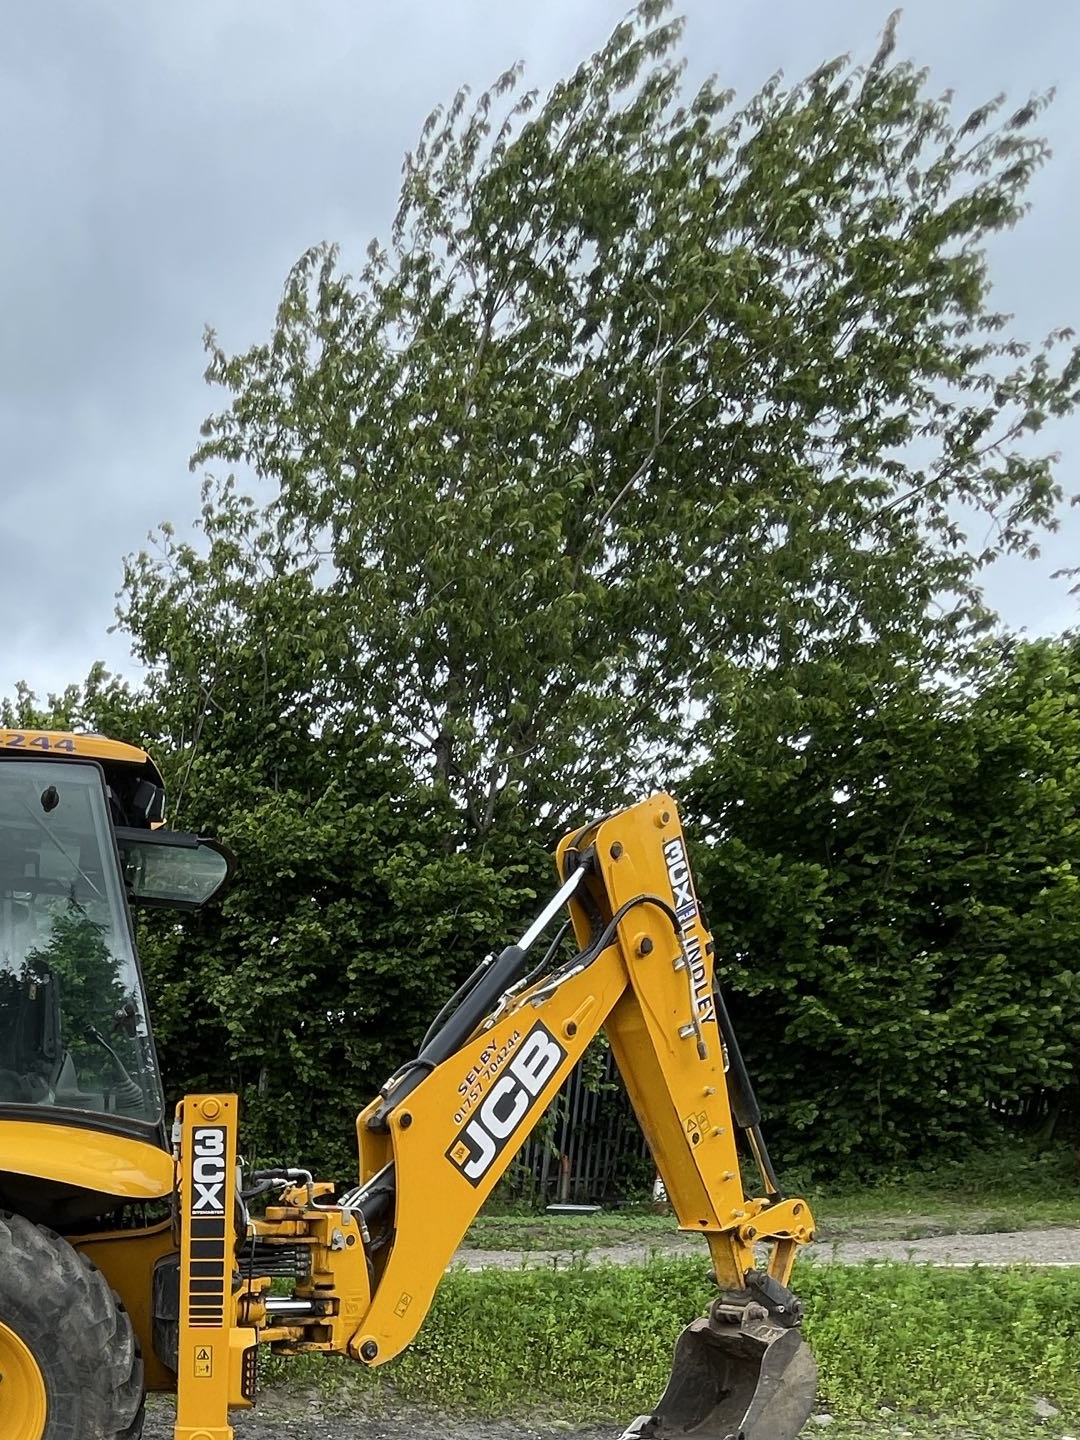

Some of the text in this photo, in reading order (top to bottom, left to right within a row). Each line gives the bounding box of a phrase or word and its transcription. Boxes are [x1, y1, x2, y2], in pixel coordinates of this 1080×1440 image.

[664, 839, 694, 909] 3CX
[682, 922, 716, 1024] LINDLEY
[453, 1029, 521, 1125] 01757 704244
[458, 1039, 498, 1096] SELBY
[463, 1030, 562, 1179] JCB
[192, 1129, 225, 1210] 3CX
